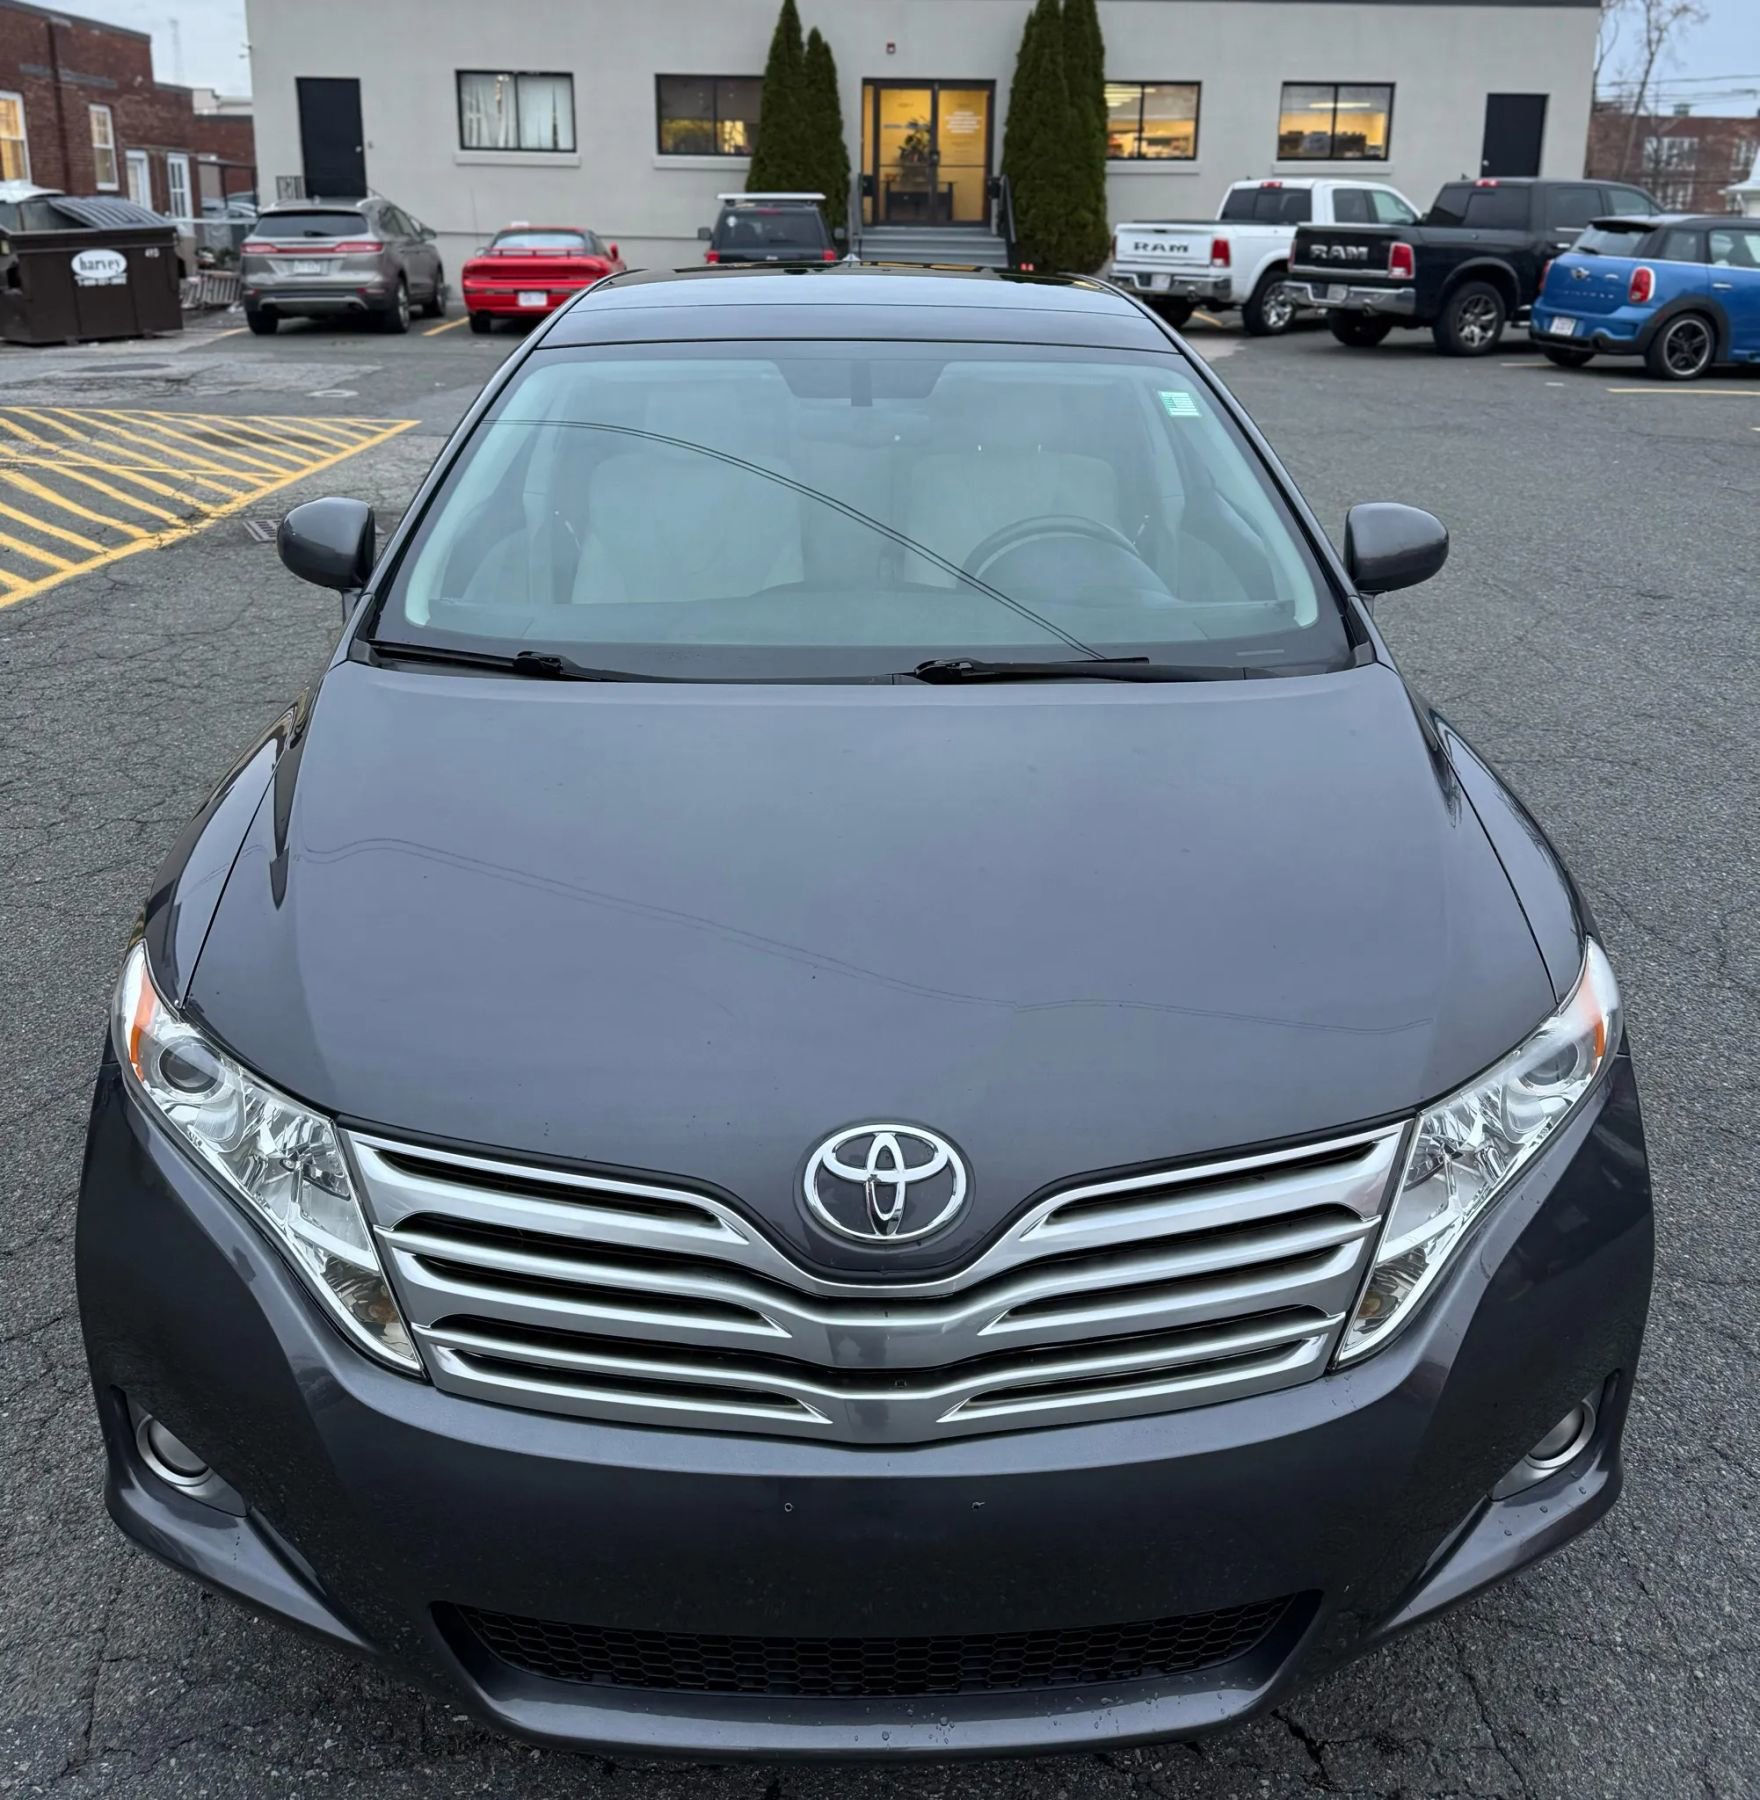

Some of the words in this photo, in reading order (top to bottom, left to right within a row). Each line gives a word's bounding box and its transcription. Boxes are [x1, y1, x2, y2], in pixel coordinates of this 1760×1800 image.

[1134, 242, 1189, 253] RAM
[1310, 244, 1369, 260] RAM
[79, 257, 120, 273] harvey
